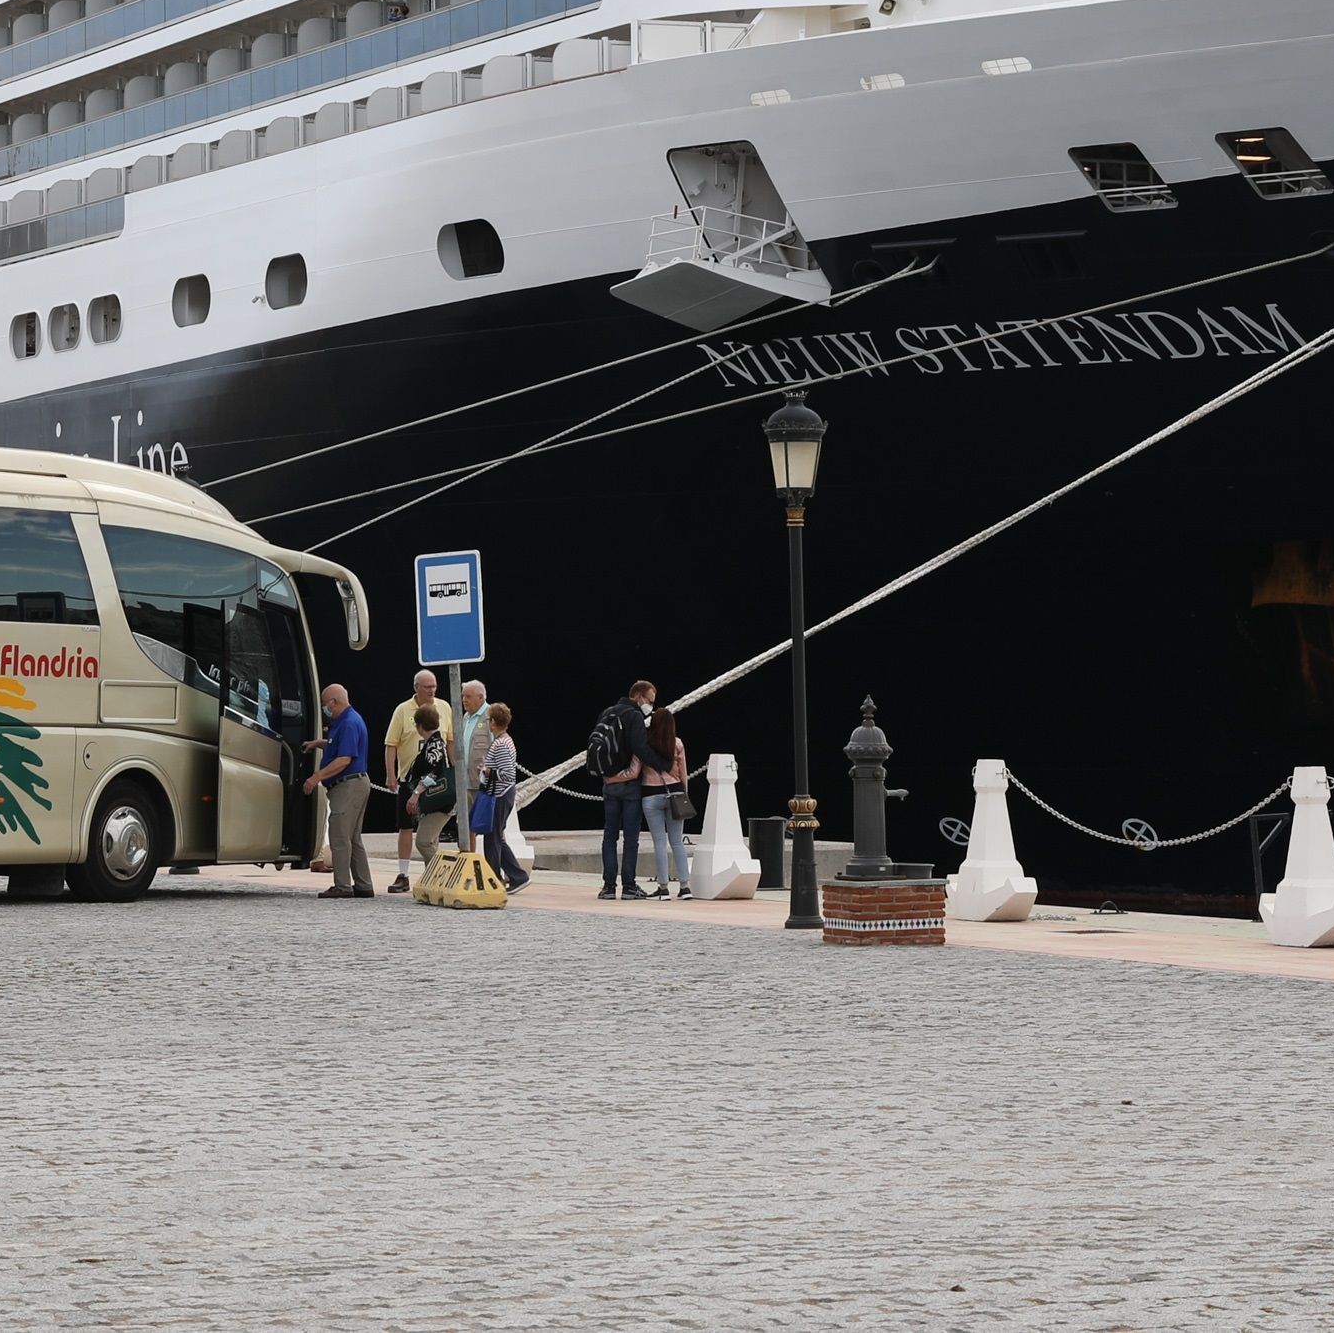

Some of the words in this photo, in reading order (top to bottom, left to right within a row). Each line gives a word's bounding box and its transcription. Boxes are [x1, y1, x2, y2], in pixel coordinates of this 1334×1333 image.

[696, 330, 890, 387] NIEUW
[895, 303, 1317, 375] STATENDAM
[0, 644, 98, 679] Flandria
